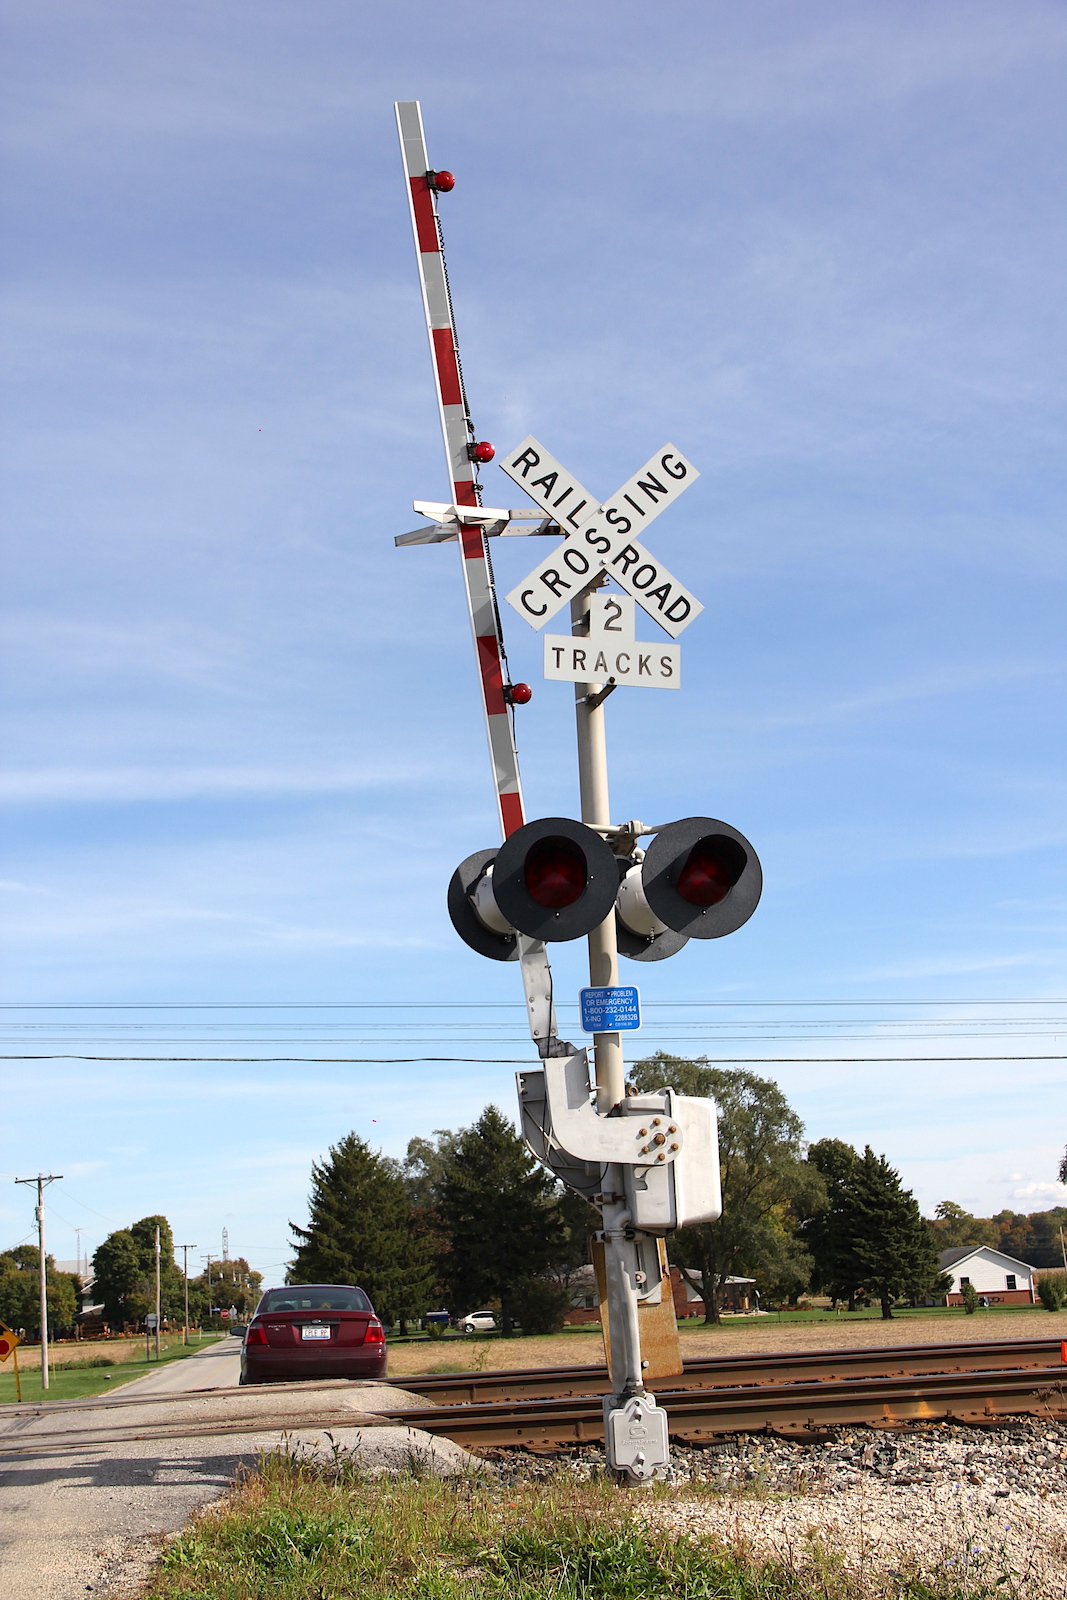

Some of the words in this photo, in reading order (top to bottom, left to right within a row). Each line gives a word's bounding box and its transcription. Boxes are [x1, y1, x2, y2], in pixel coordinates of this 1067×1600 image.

[512, 447, 587, 529] RAIL
[612, 544, 691, 623] ROAD
[521, 454, 687, 617] CROSSING
[604, 602, 622, 632] 2
[552, 647, 673, 678] TRACKS
[584, 1006, 637, 1014] 1-800-232-0144
[596, 998, 633, 1006] EMERGENCY
